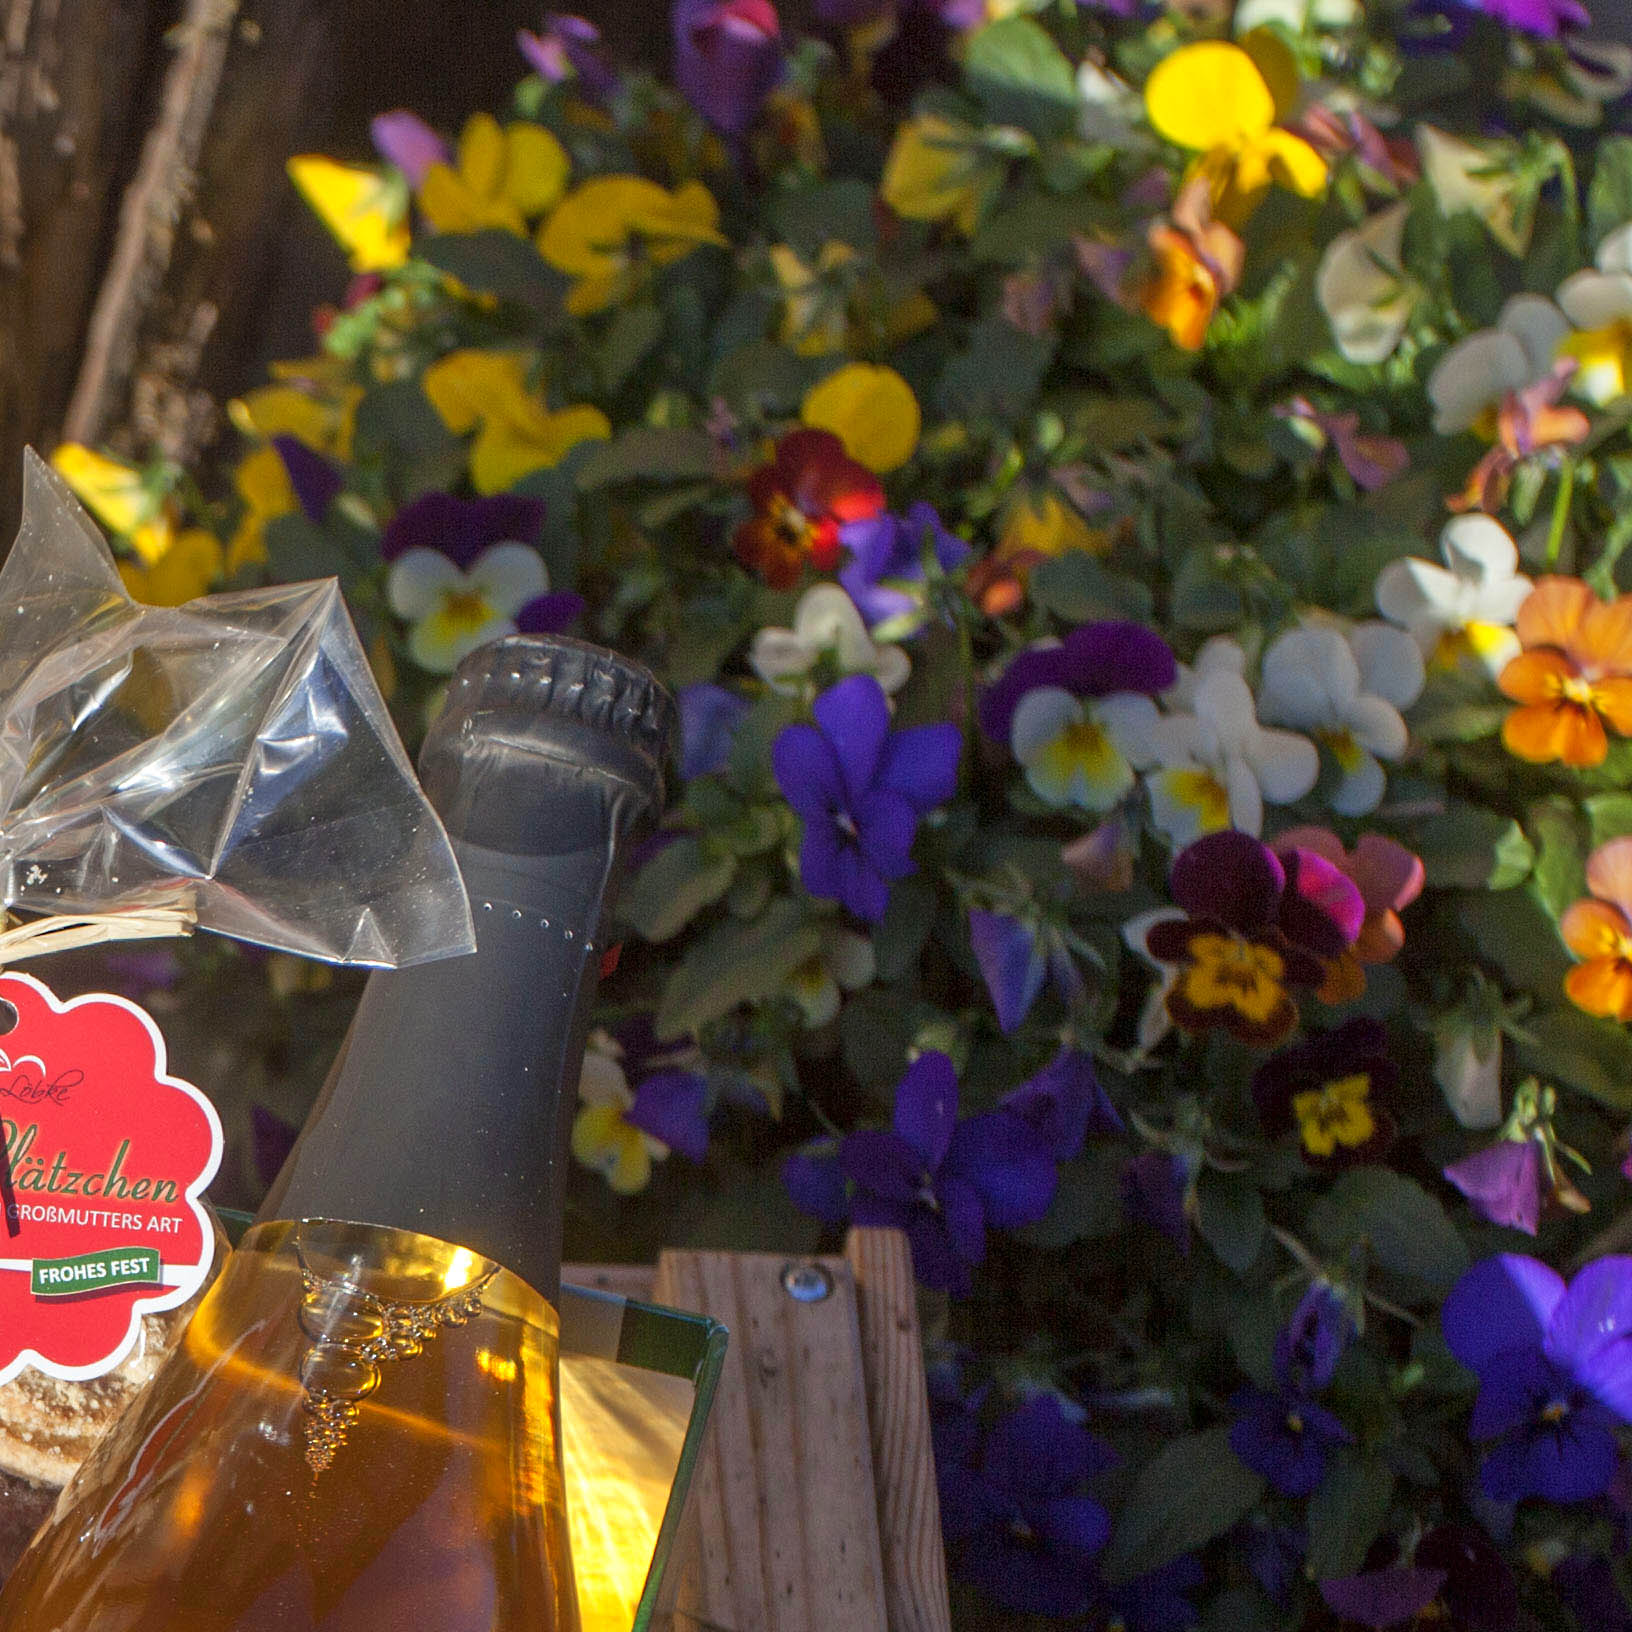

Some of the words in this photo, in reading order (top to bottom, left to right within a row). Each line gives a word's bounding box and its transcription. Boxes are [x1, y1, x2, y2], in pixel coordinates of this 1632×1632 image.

[9, 1203, 144, 1232] GROßMUTTERS
[146, 1216, 184, 1235] ART
[38, 1262, 107, 1285] FROHES
[111, 1257, 151, 1277] FEST
